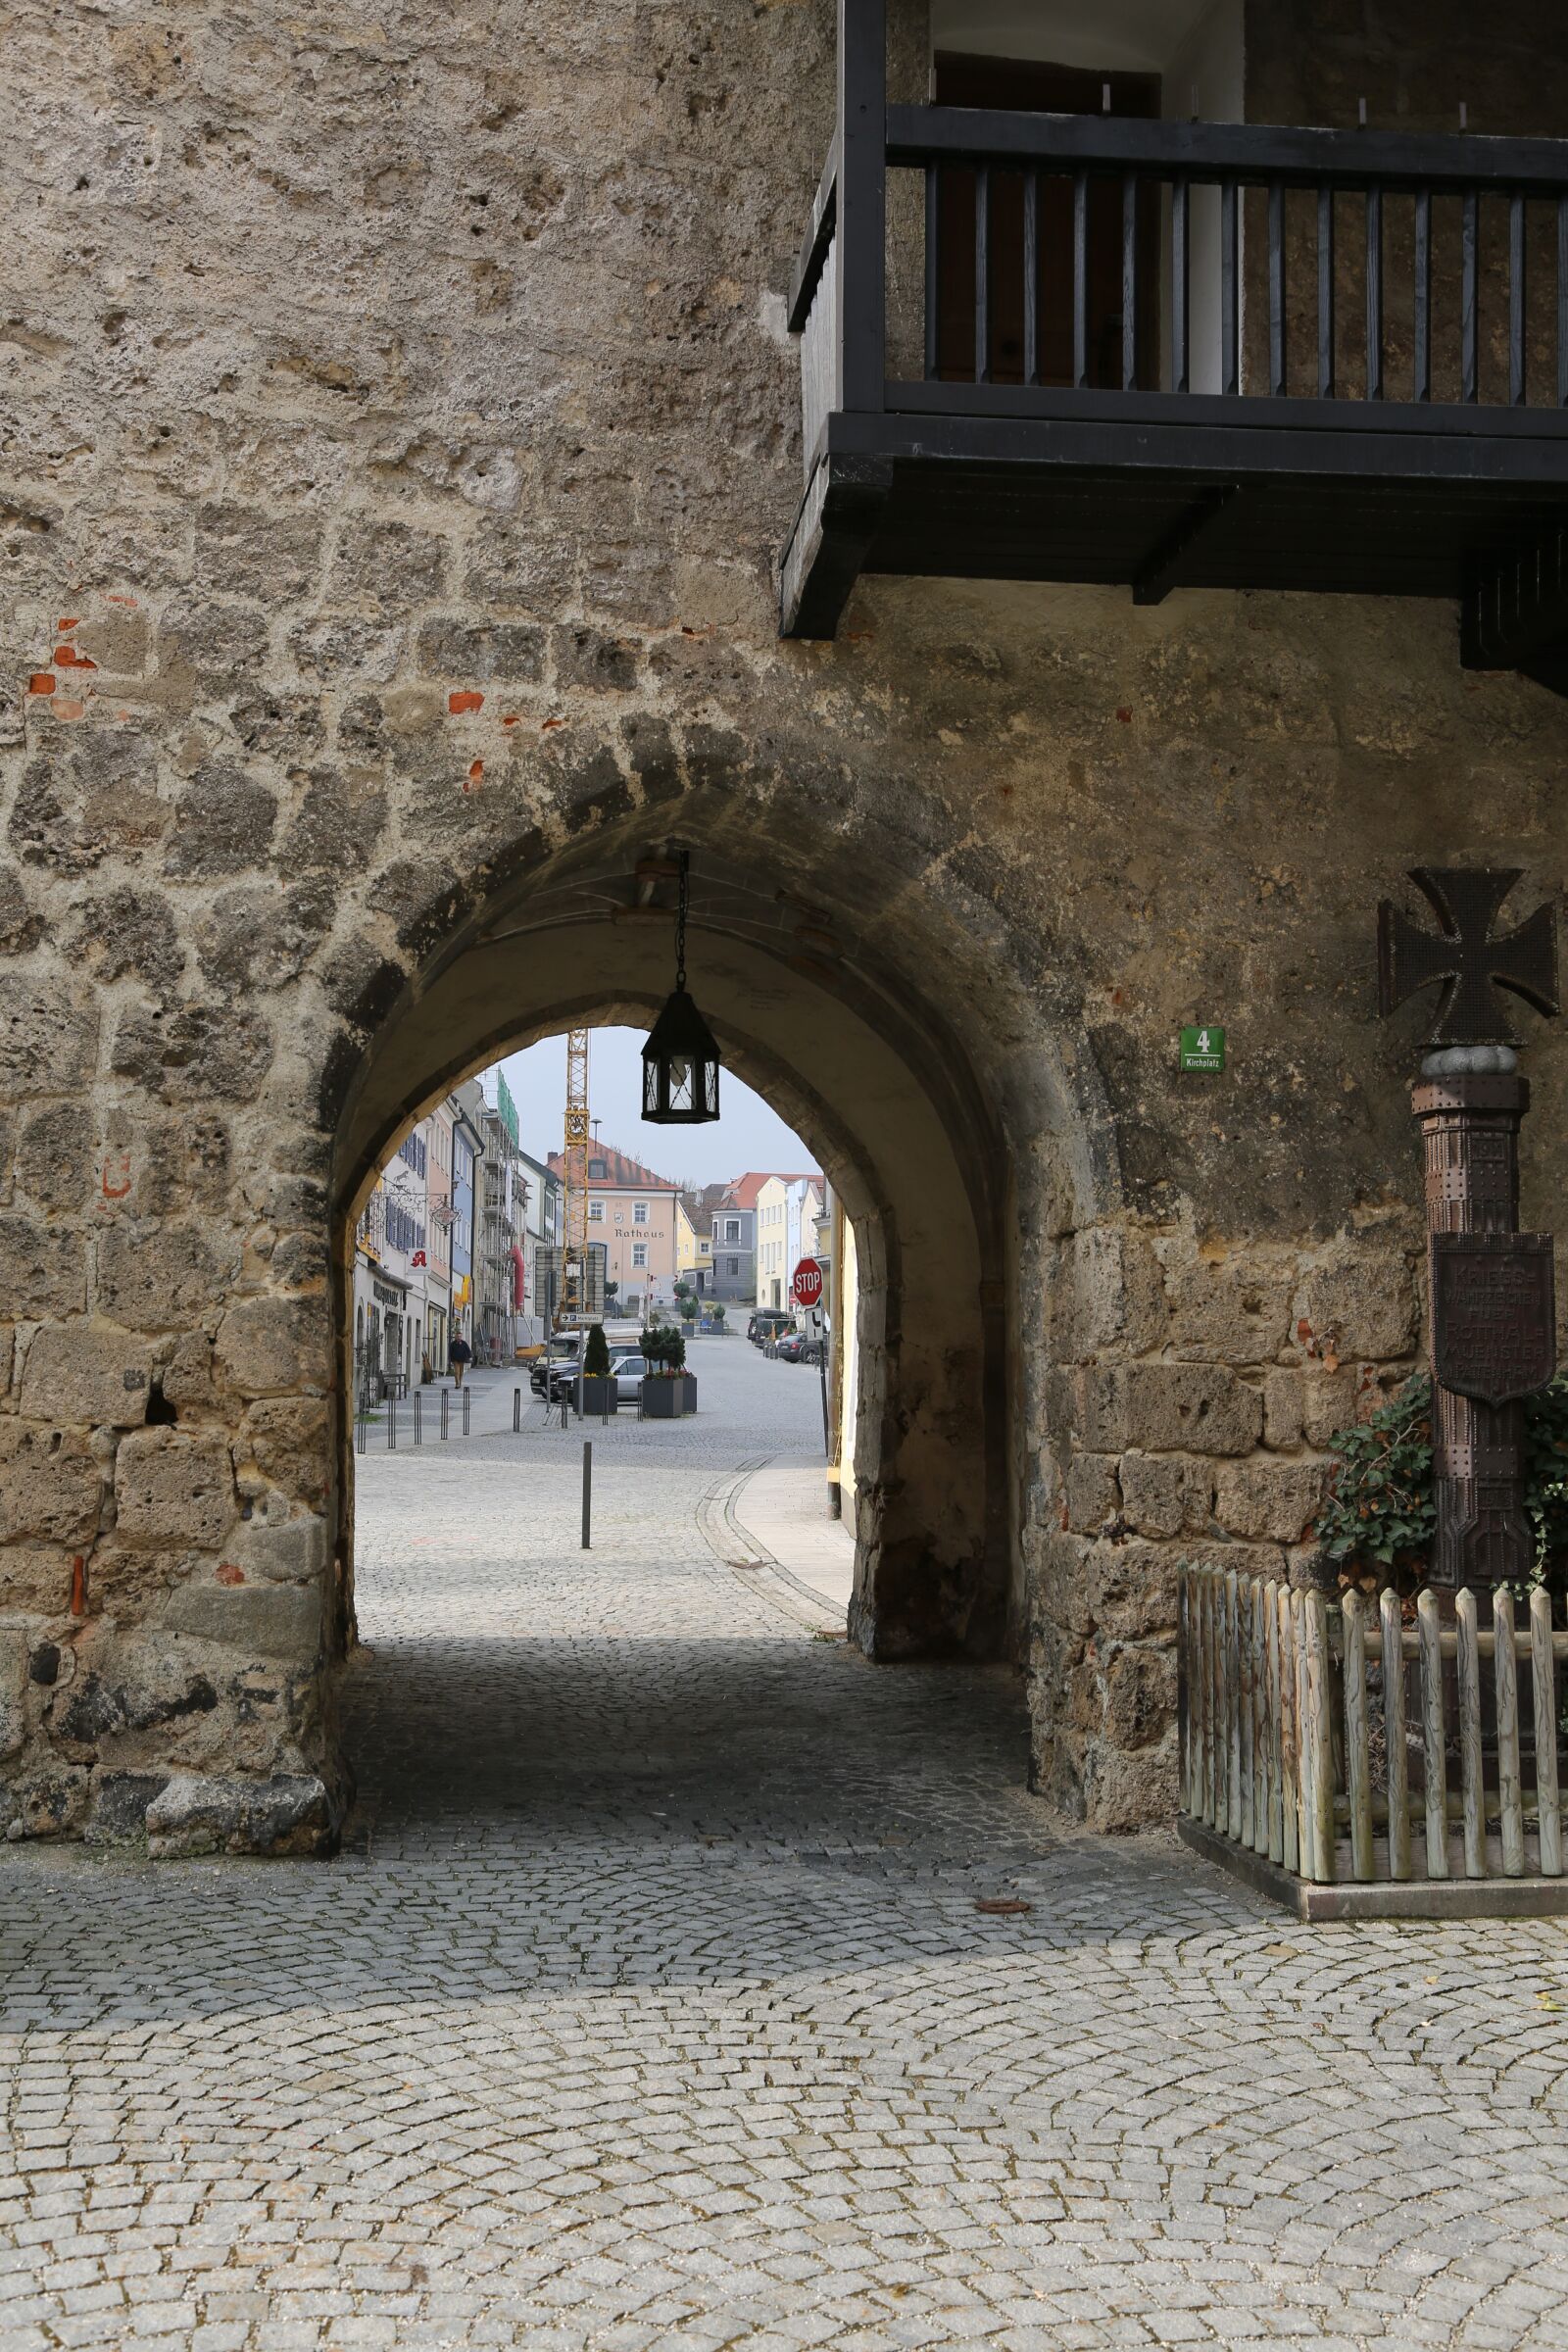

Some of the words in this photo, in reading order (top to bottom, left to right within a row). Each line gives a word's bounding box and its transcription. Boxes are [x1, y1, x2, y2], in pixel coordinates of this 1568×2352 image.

[1197, 1030, 1210, 1054] 4
[1186, 1057, 1220, 1068] Kirchplatz
[614, 1228, 664, 1239] Rathaus
[796, 1271, 820, 1294] STOP
